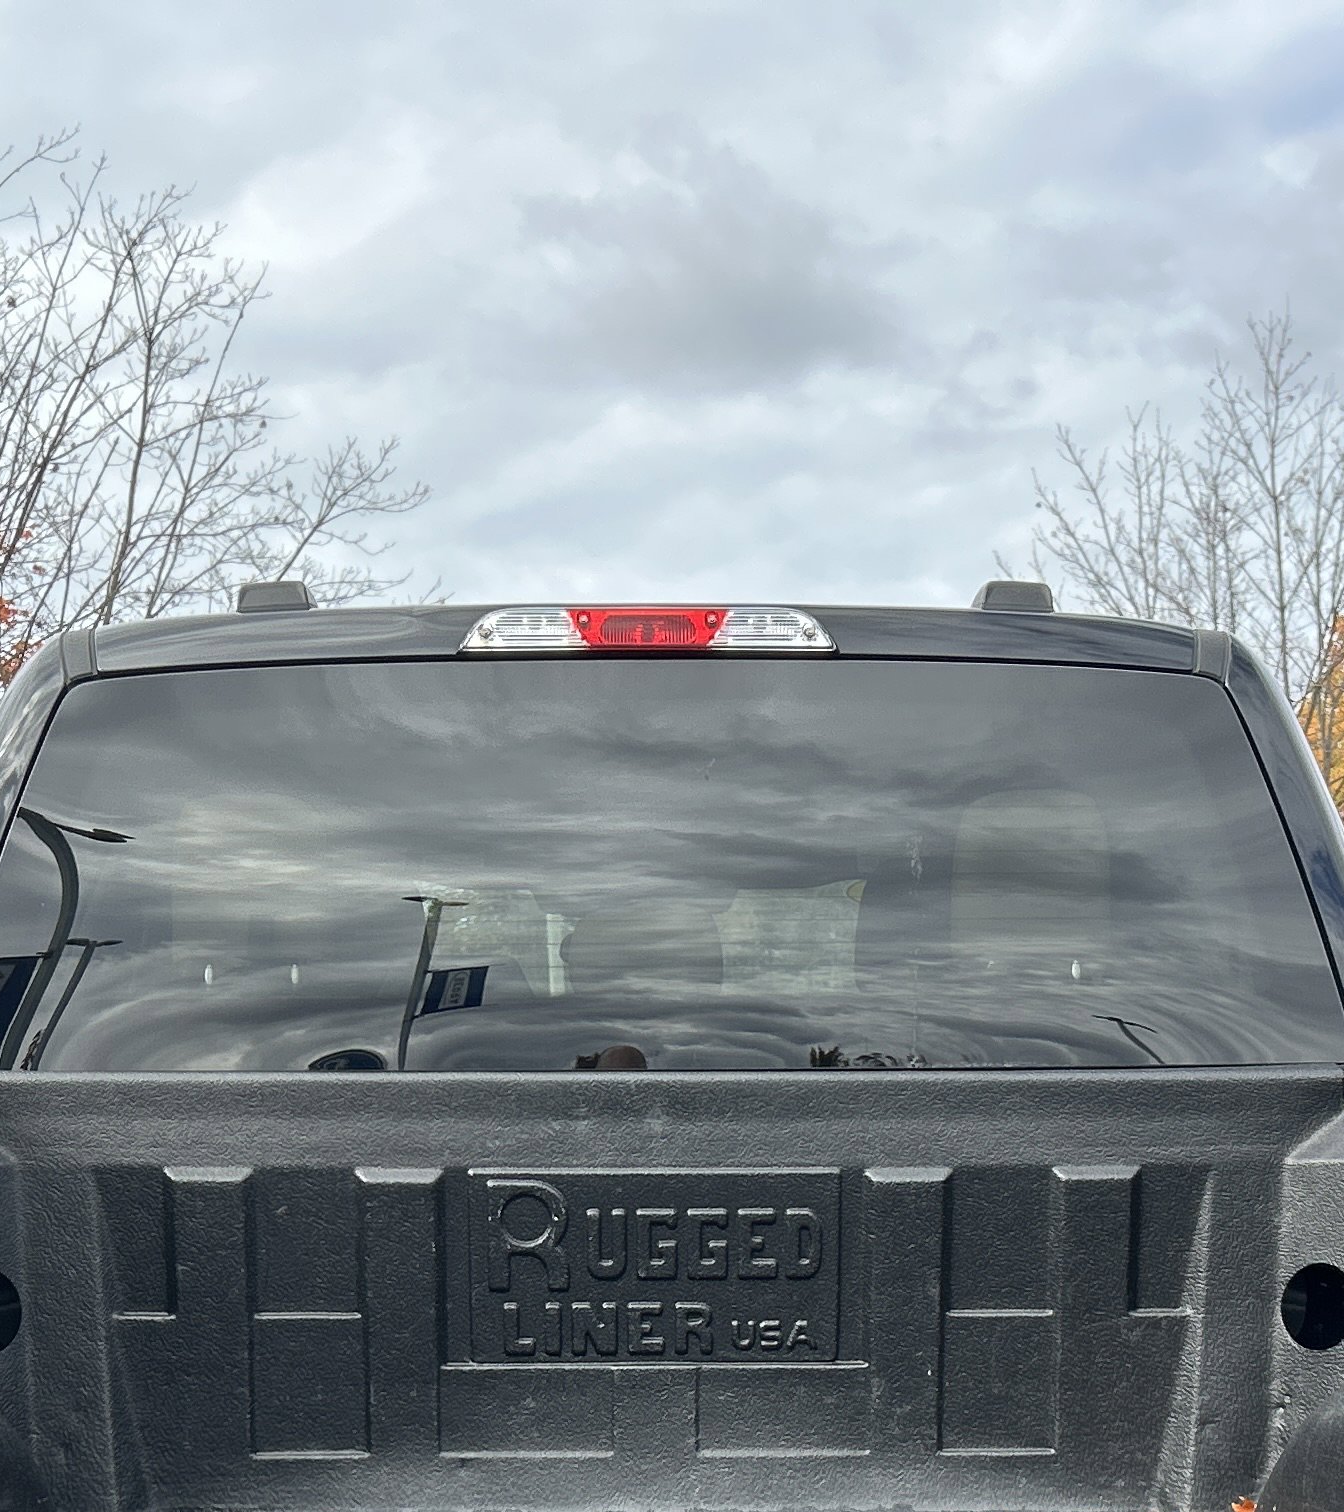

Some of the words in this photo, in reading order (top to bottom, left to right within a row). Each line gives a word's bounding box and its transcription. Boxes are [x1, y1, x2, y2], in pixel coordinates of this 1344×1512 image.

[487, 1179, 822, 1292] RUGGED
[503, 1301, 714, 1356] LINER
[730, 1319, 818, 1351] USA
